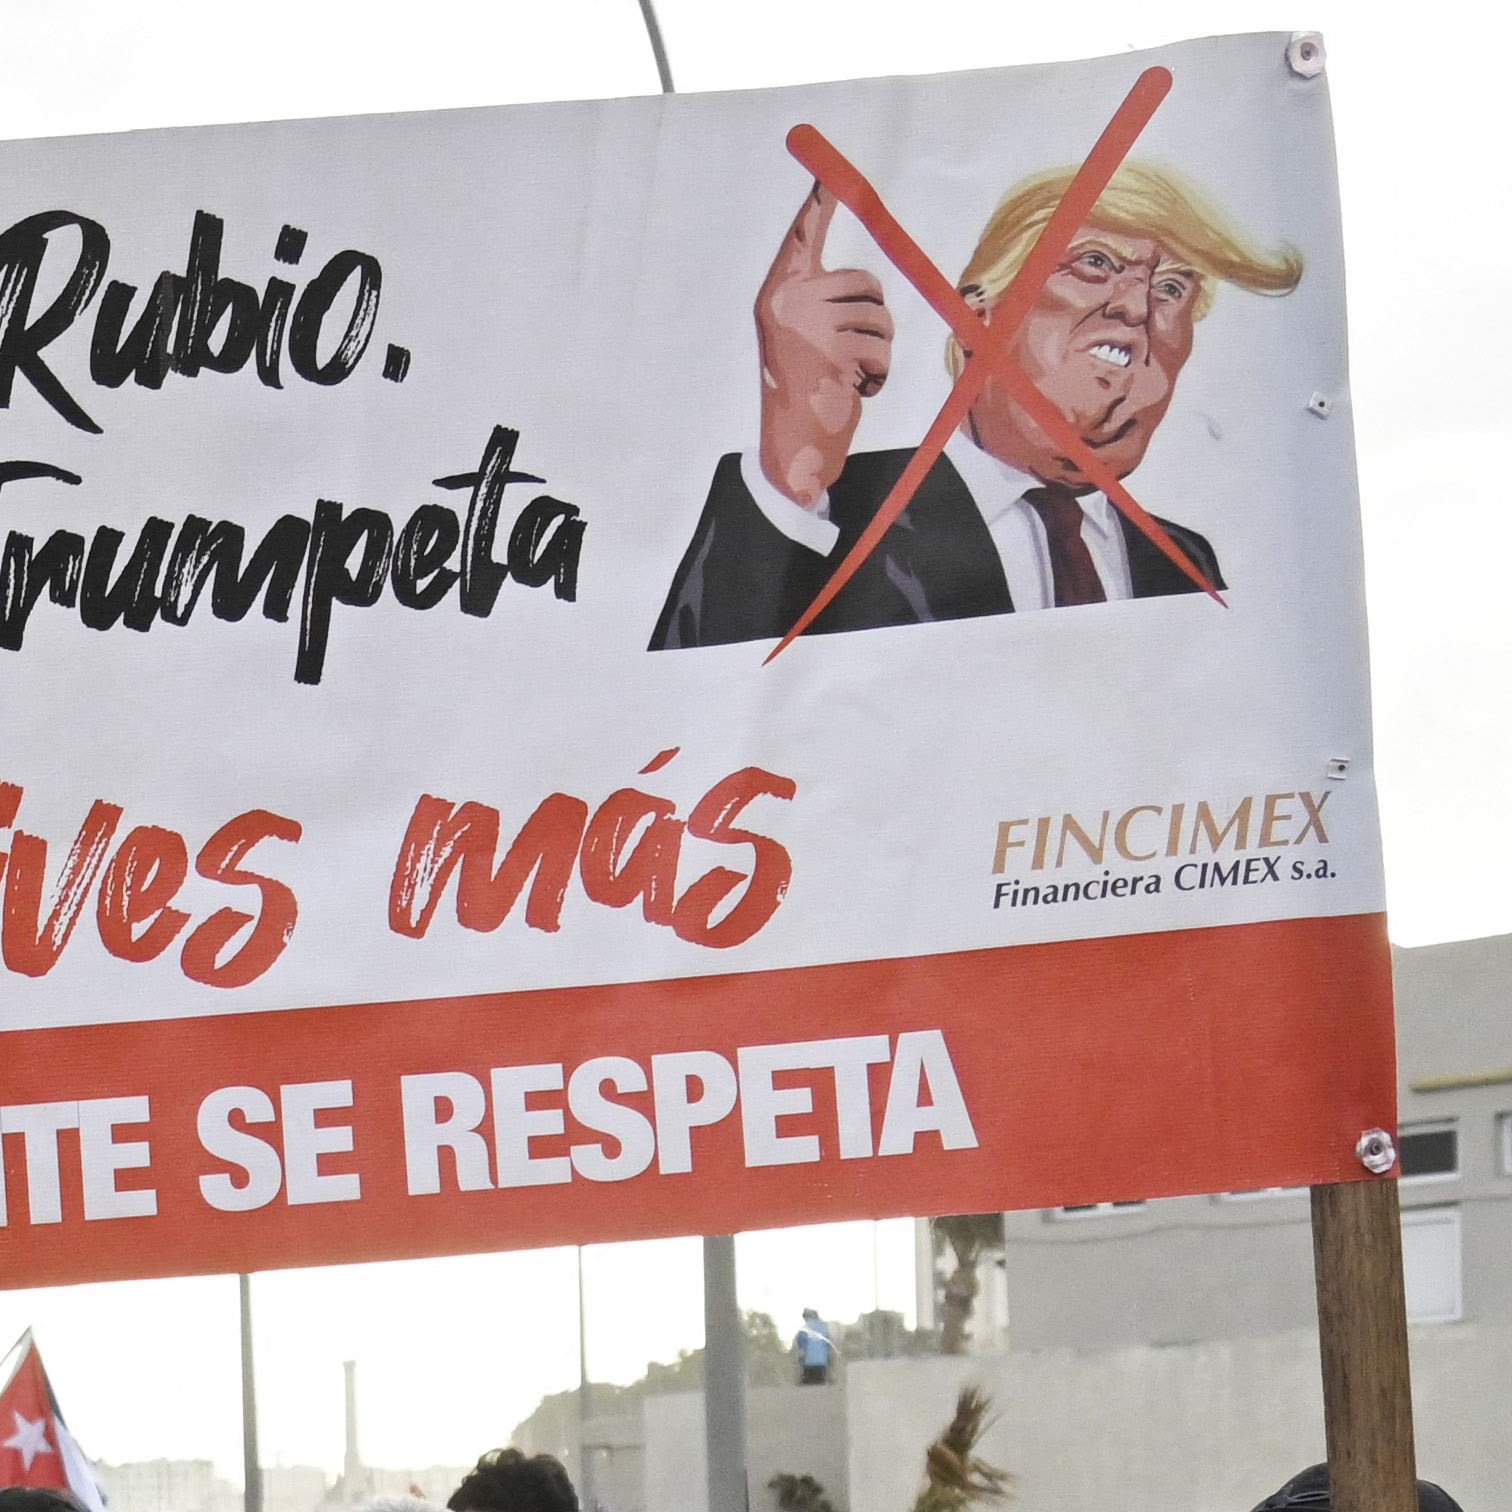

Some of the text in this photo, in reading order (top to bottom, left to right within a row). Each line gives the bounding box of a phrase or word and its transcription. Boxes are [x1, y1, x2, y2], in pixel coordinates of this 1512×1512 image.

[389, 746, 797, 949] más
[991, 789, 1332, 875] FINCIMEX
[992, 855, 1337, 909] Financiera CIMEX s.a.
[196, 1079, 362, 1212] SE
[399, 1028, 980, 1196] RESPETA
